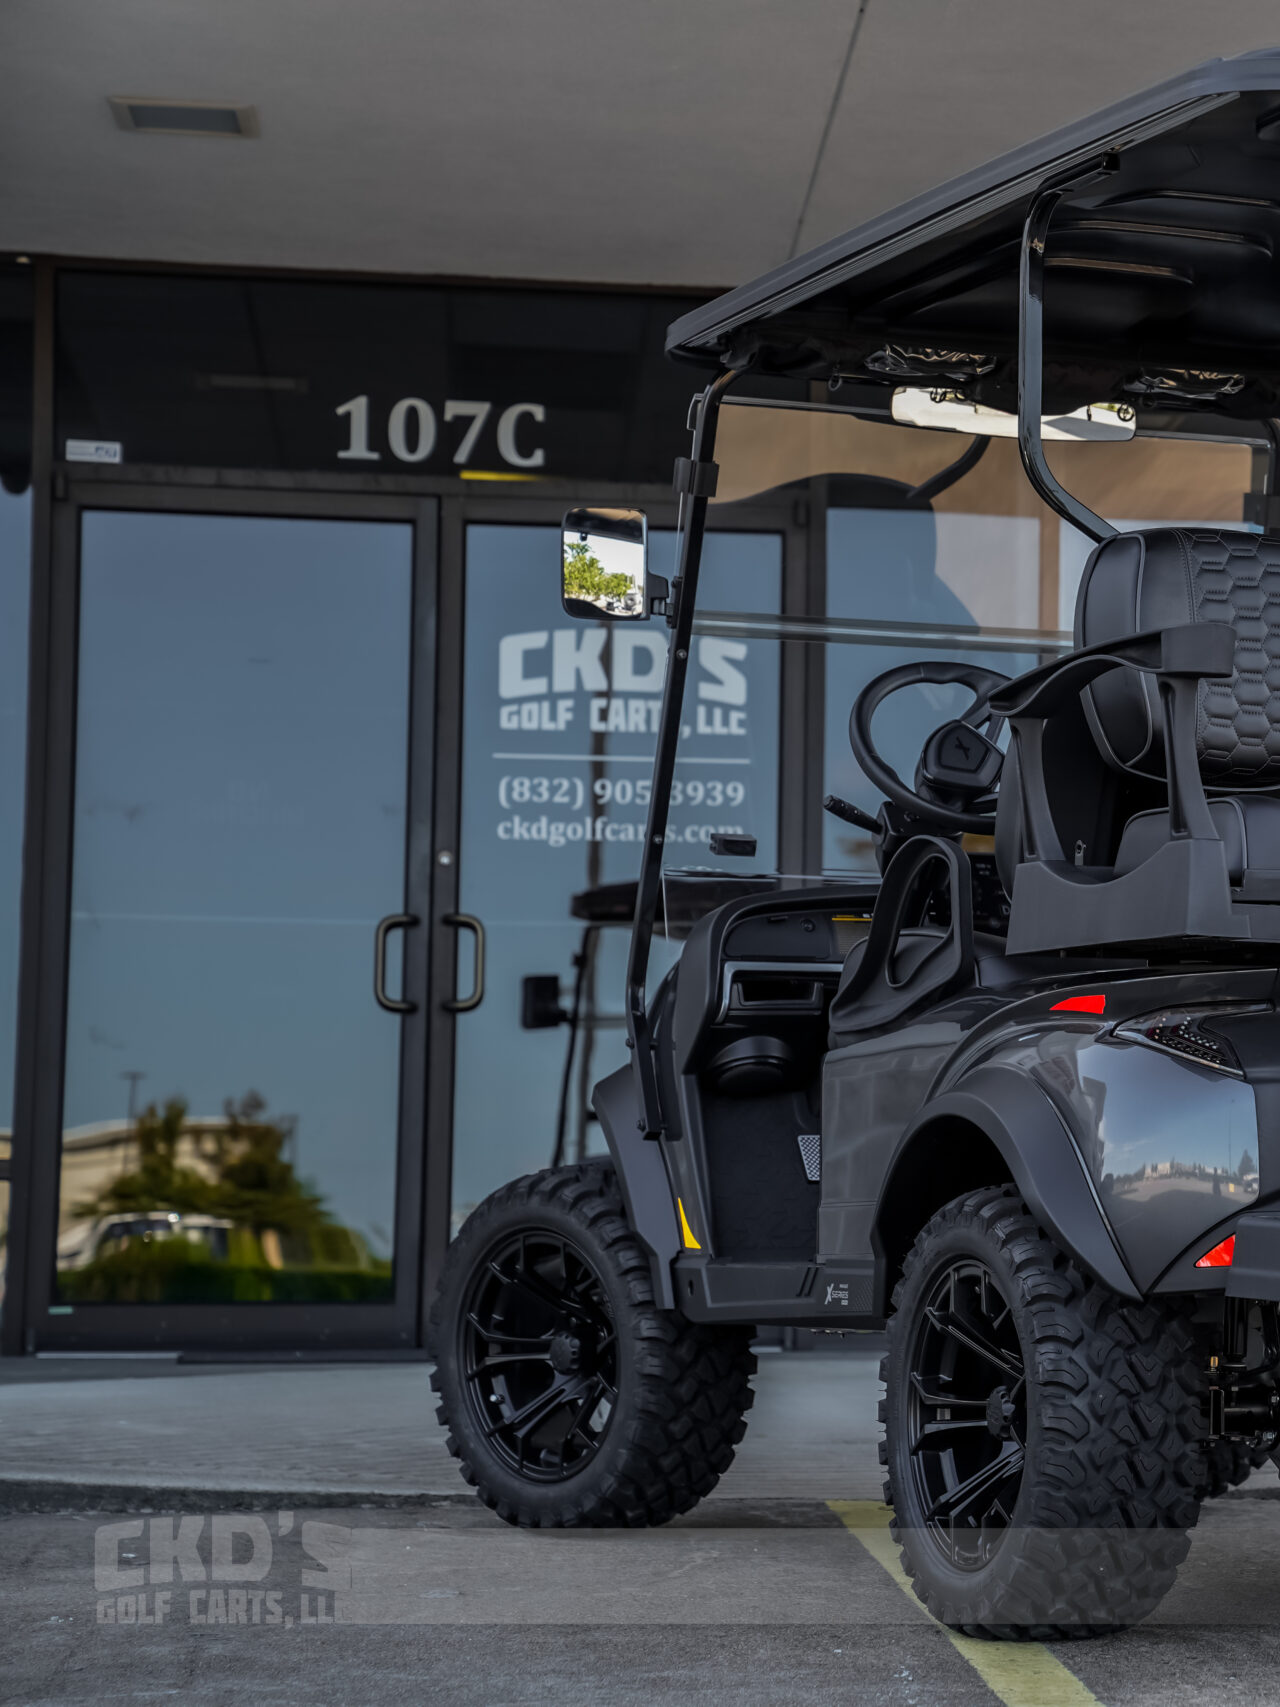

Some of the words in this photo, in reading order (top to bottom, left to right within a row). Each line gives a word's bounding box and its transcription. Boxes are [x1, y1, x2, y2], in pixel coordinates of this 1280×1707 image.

[335, 395, 546, 467] 107C
[499, 699, 575, 731] GOLF
[696, 704, 748, 735] LLC
[498, 775, 584, 810] (832)
